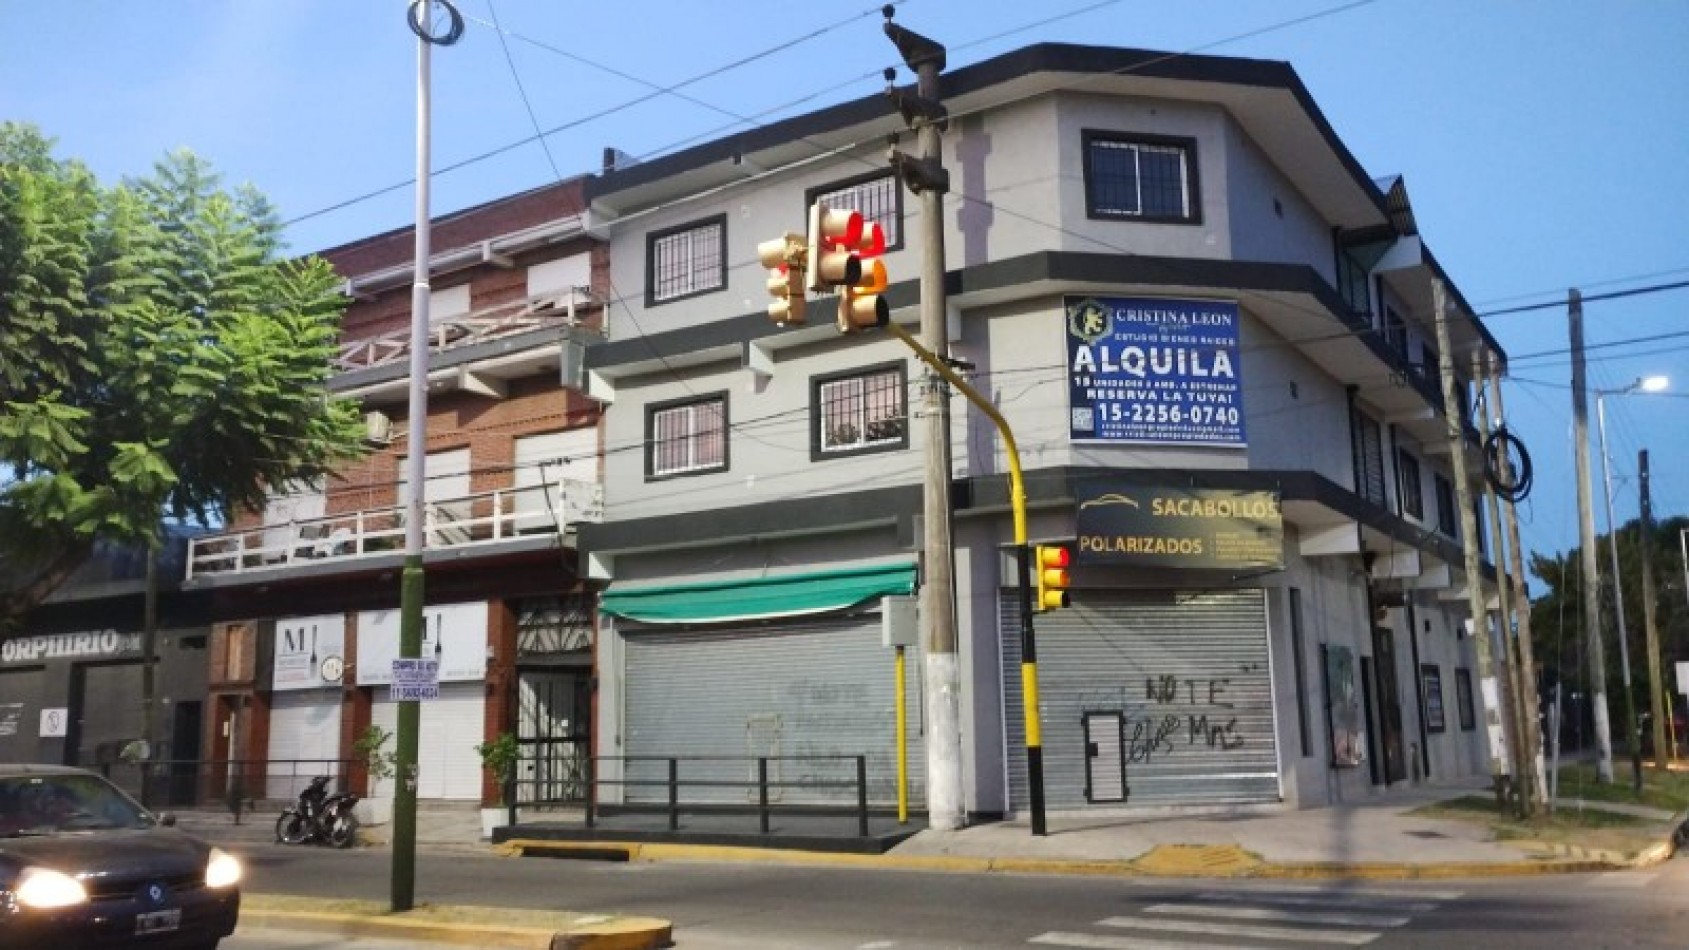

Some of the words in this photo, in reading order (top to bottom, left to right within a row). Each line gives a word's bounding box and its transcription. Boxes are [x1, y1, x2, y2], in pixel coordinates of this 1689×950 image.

[1116, 309, 1188, 324] CRISTINA
[1192, 312, 1232, 326] LEON
[1073, 345, 1234, 378] ALQUILA
[1086, 388, 1158, 400] RESERVA
[1162, 391, 1183, 402] LA
[1099, 402, 1239, 425] 15-2256-0740
[1152, 497, 1279, 518] SACABOLLOS
[1080, 535, 1202, 554] POLARIZADOS
